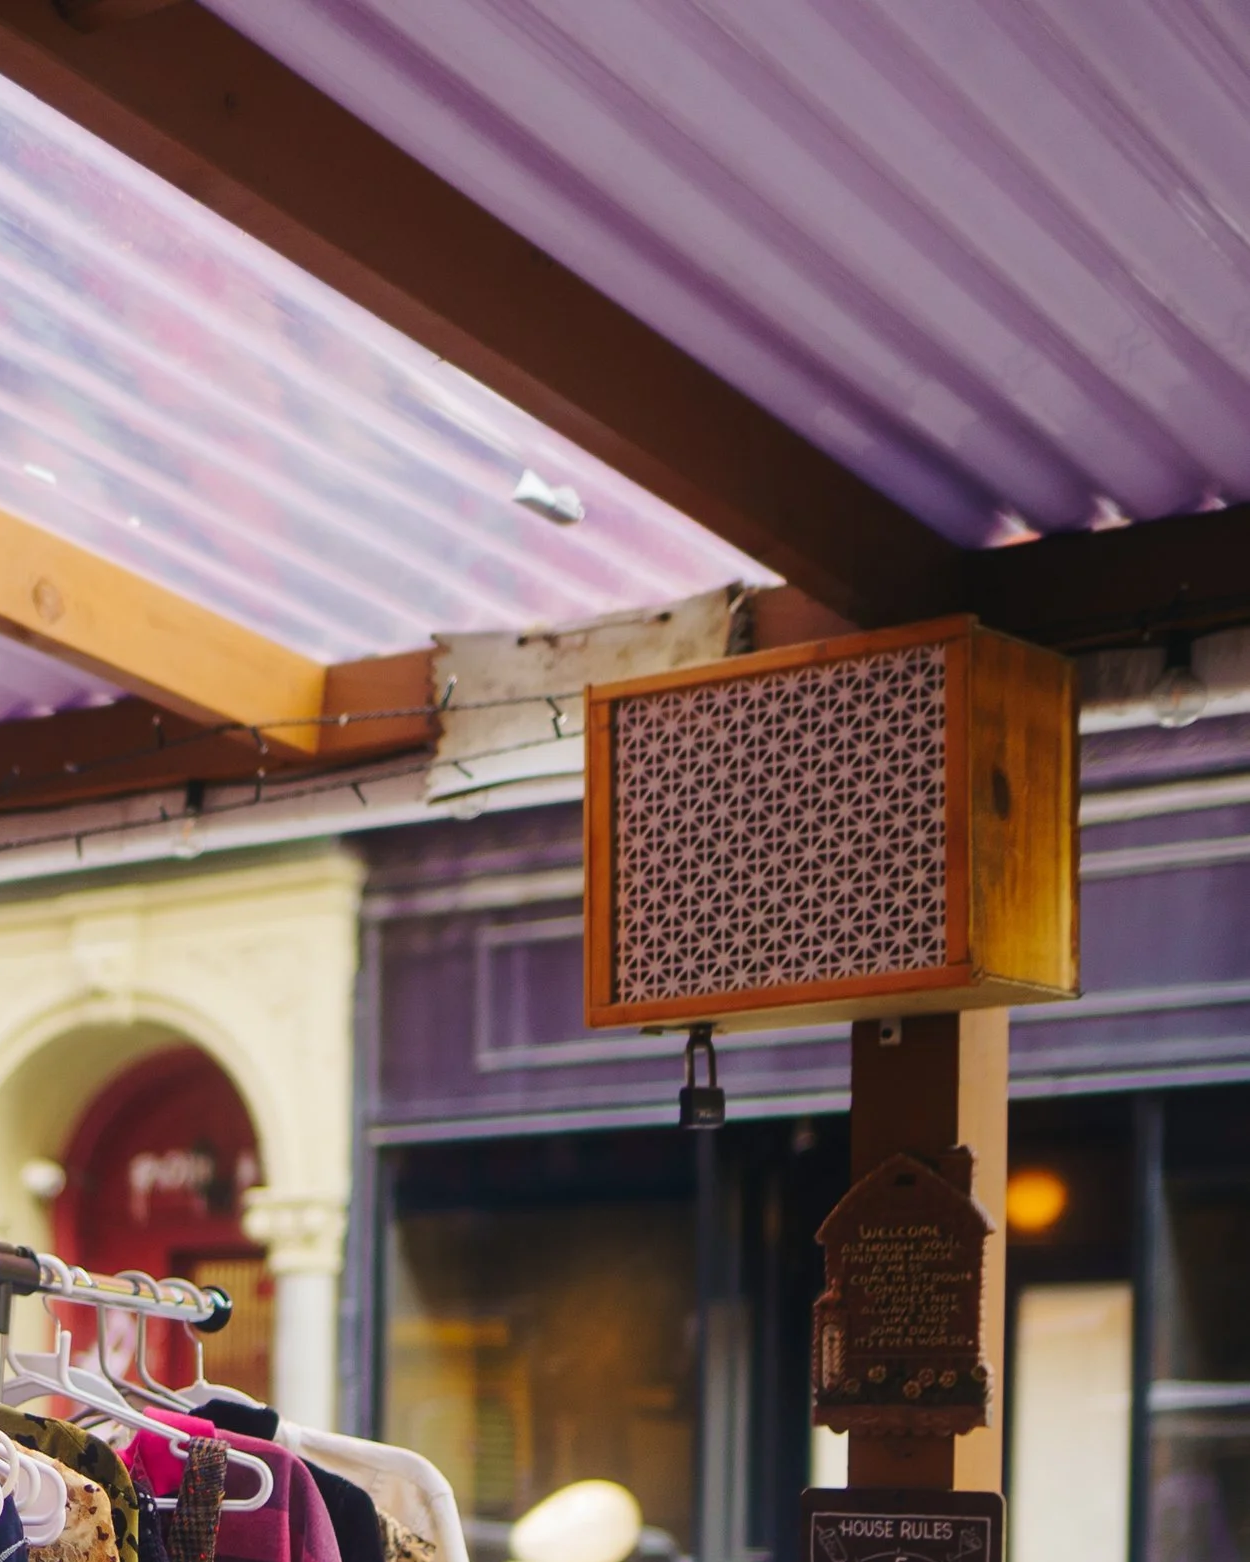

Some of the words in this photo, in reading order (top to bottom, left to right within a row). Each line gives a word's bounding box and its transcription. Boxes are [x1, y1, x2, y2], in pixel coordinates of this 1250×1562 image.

[859, 1224, 941, 1240] WELCOME
[850, 1273, 887, 1285] COME
[930, 1293, 959, 1303] NOT
[922, 1304, 961, 1314] LOOK
[839, 1519, 894, 1540] HOUSE
[901, 1521, 954, 1541] RULES
